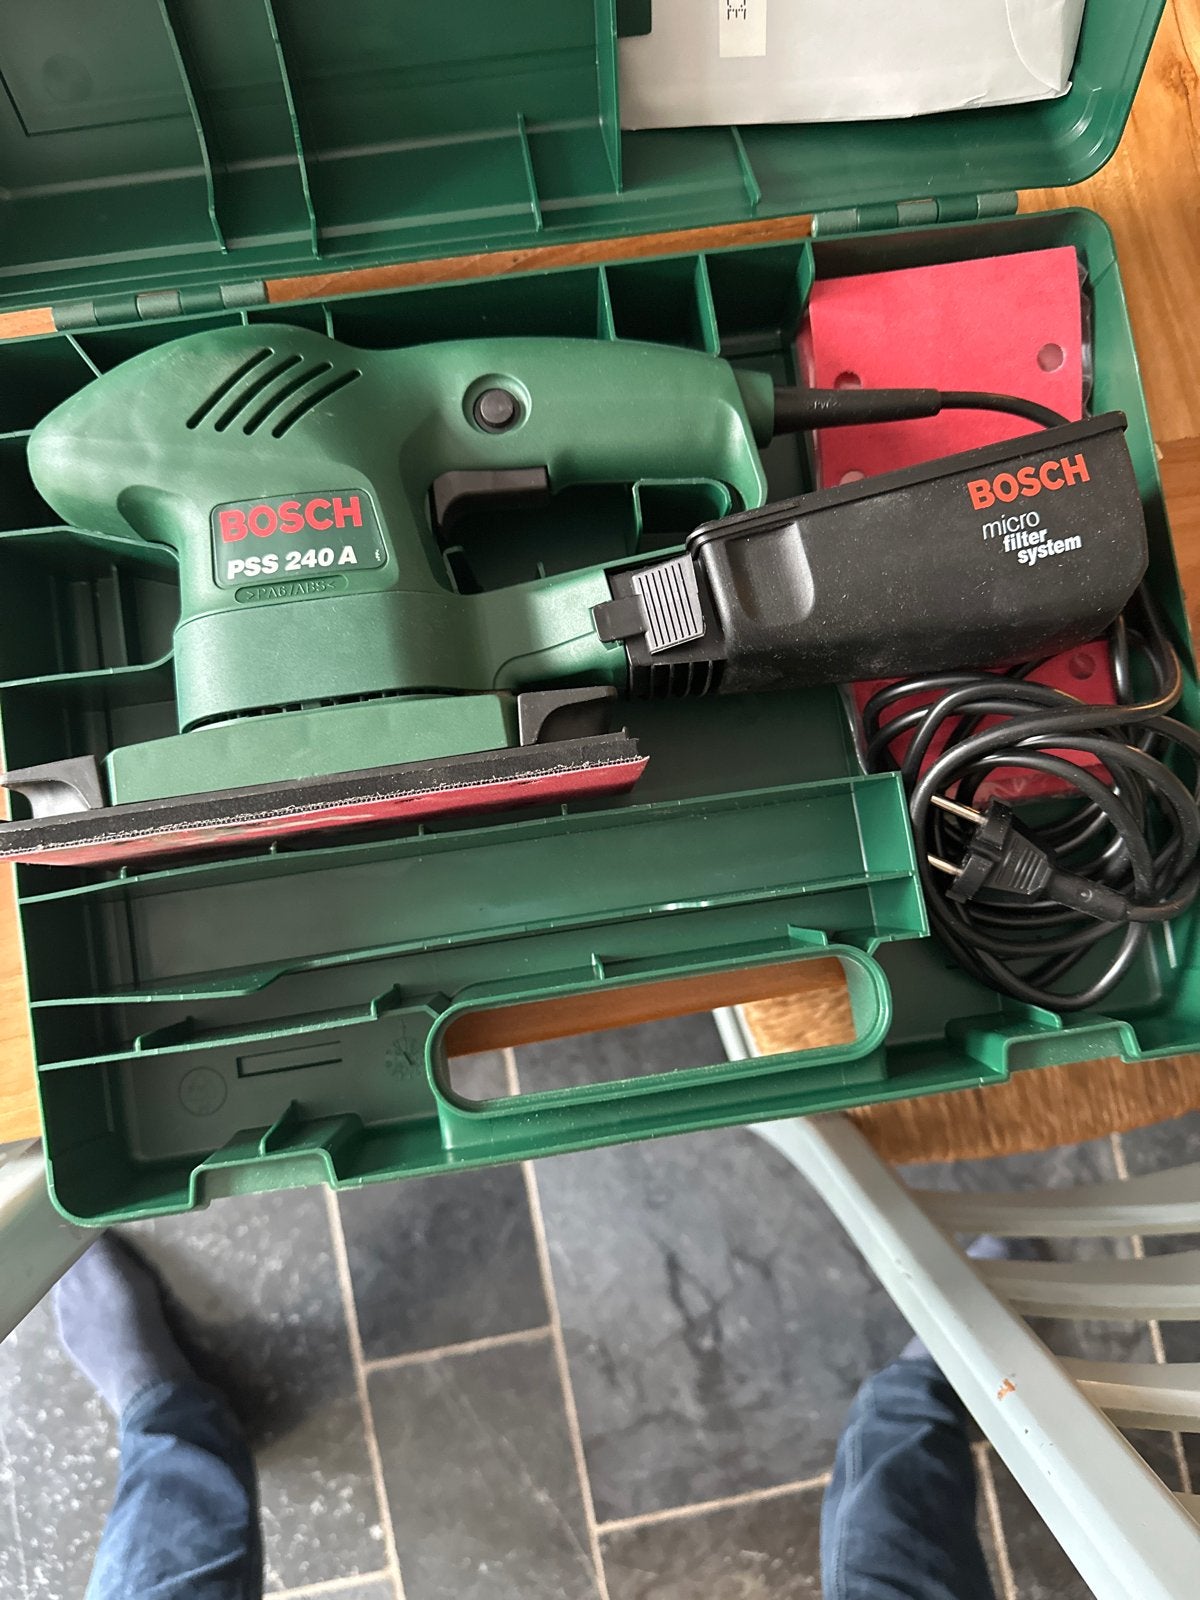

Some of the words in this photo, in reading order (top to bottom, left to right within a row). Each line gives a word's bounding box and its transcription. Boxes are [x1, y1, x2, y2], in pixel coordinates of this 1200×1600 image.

[967, 453, 1091, 511] BOSCH
[219, 496, 363, 544] BOSCH
[982, 511, 1041, 540] micro
[1002, 528, 1048, 553] filter
[1017, 535, 1082, 567] system
[227, 553, 279, 580] PSS
[285, 547, 335, 571] 240
[338, 545, 358, 565] A
